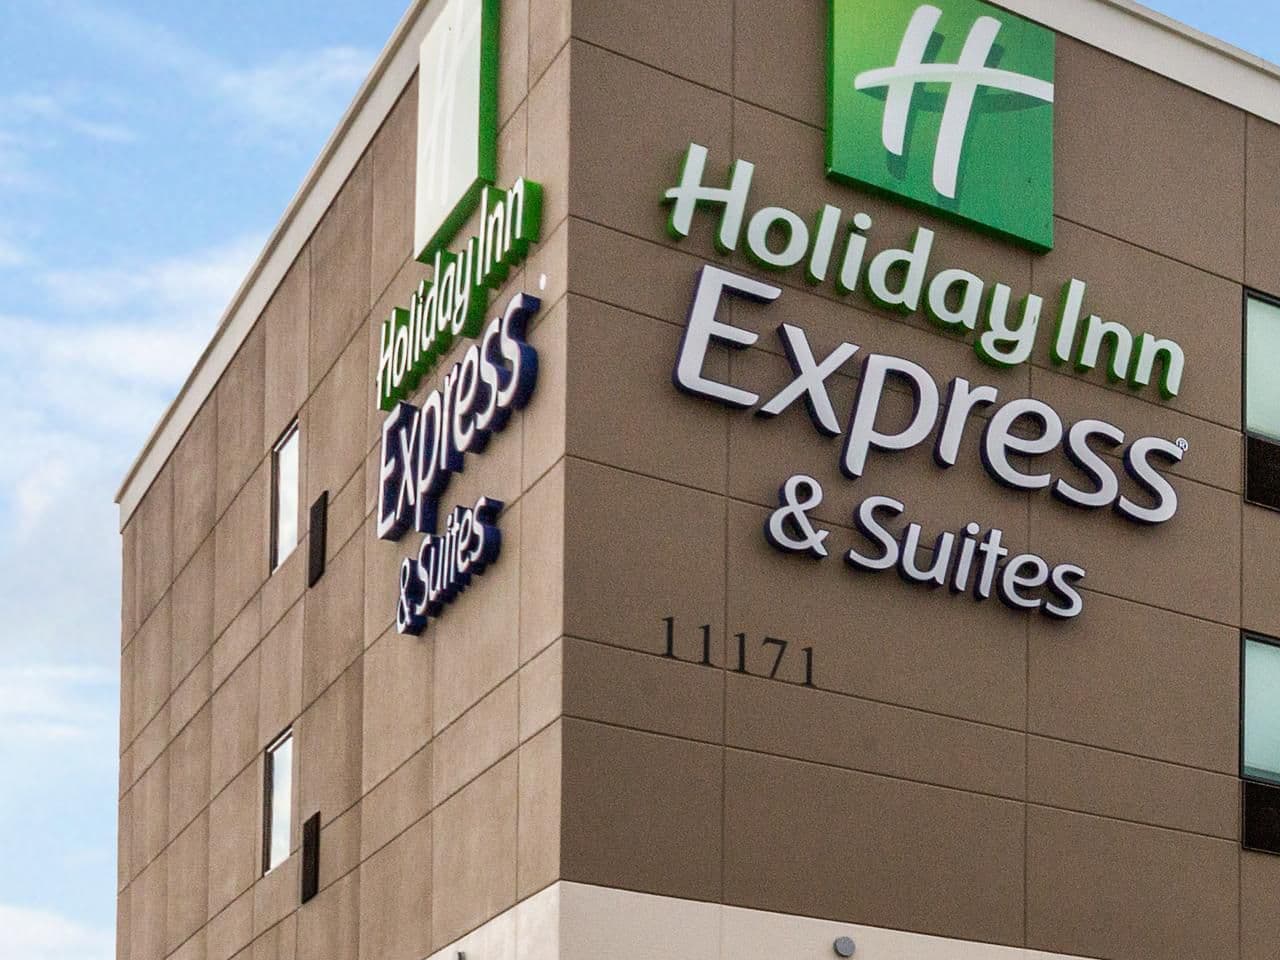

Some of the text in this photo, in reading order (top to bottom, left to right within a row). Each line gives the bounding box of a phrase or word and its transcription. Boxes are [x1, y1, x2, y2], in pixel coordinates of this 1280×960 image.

[377, 176, 533, 410] Holiday Inn
[664, 142, 1186, 398] Holiday Inn
[377, 293, 535, 540] Express
[673, 264, 1186, 525] Express
[397, 496, 497, 635] & Suites
[662, 617, 817, 688] 11171
[766, 474, 1086, 619] & Suites
